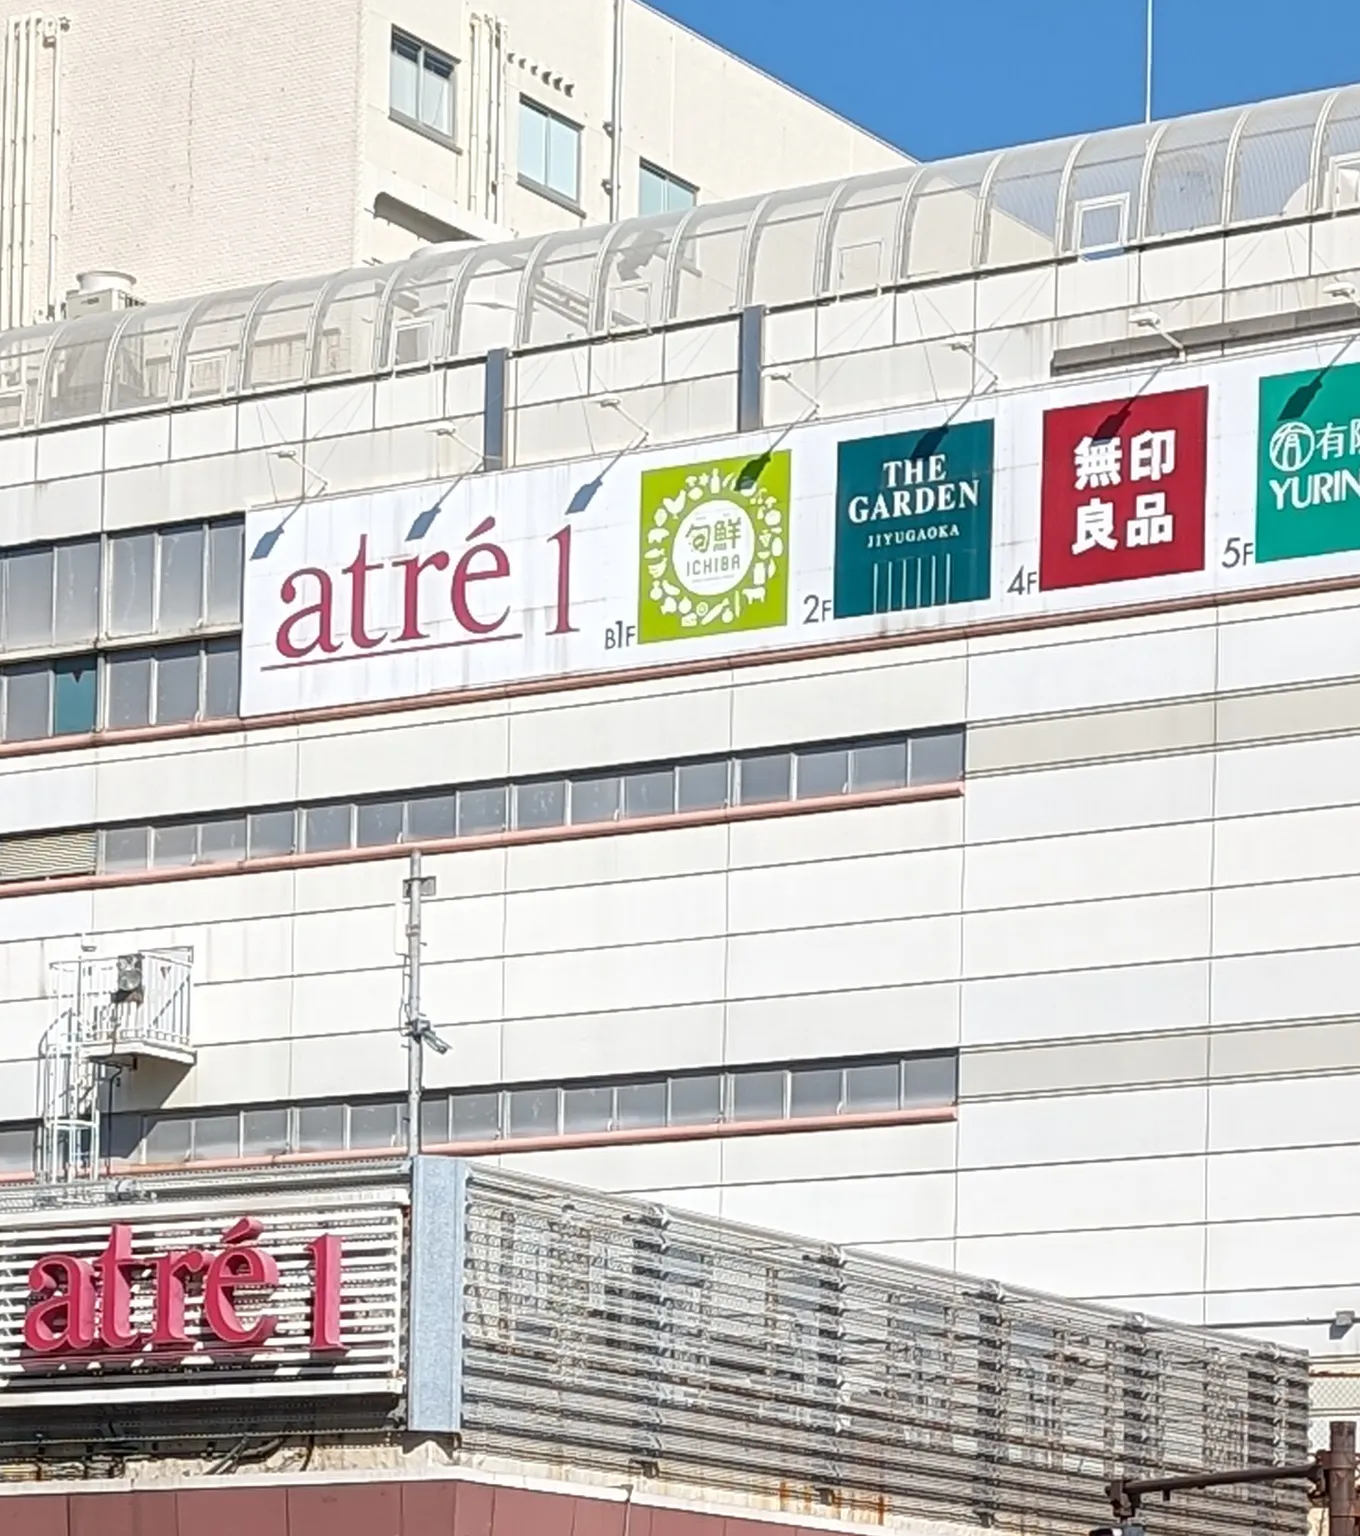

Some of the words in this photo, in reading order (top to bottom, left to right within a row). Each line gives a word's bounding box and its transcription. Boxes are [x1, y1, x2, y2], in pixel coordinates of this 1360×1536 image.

[883, 454, 947, 488] THE
[1074, 430, 1176, 490] 無印
[848, 480, 980, 524] GARDEN
[867, 524, 960, 548] JIYUGAOKA
[1071, 492, 1173, 555] 良品
[686, 554, 741, 577] ICHIBA
[1222, 537, 1254, 568] 5F
[275, 516, 511, 659] atré
[545, 523, 580, 636] 1
[1007, 565, 1037, 595] 4F
[803, 594, 832, 625] 2F
[605, 620, 636, 650] B1F
[22, 1217, 280, 1352] atré
